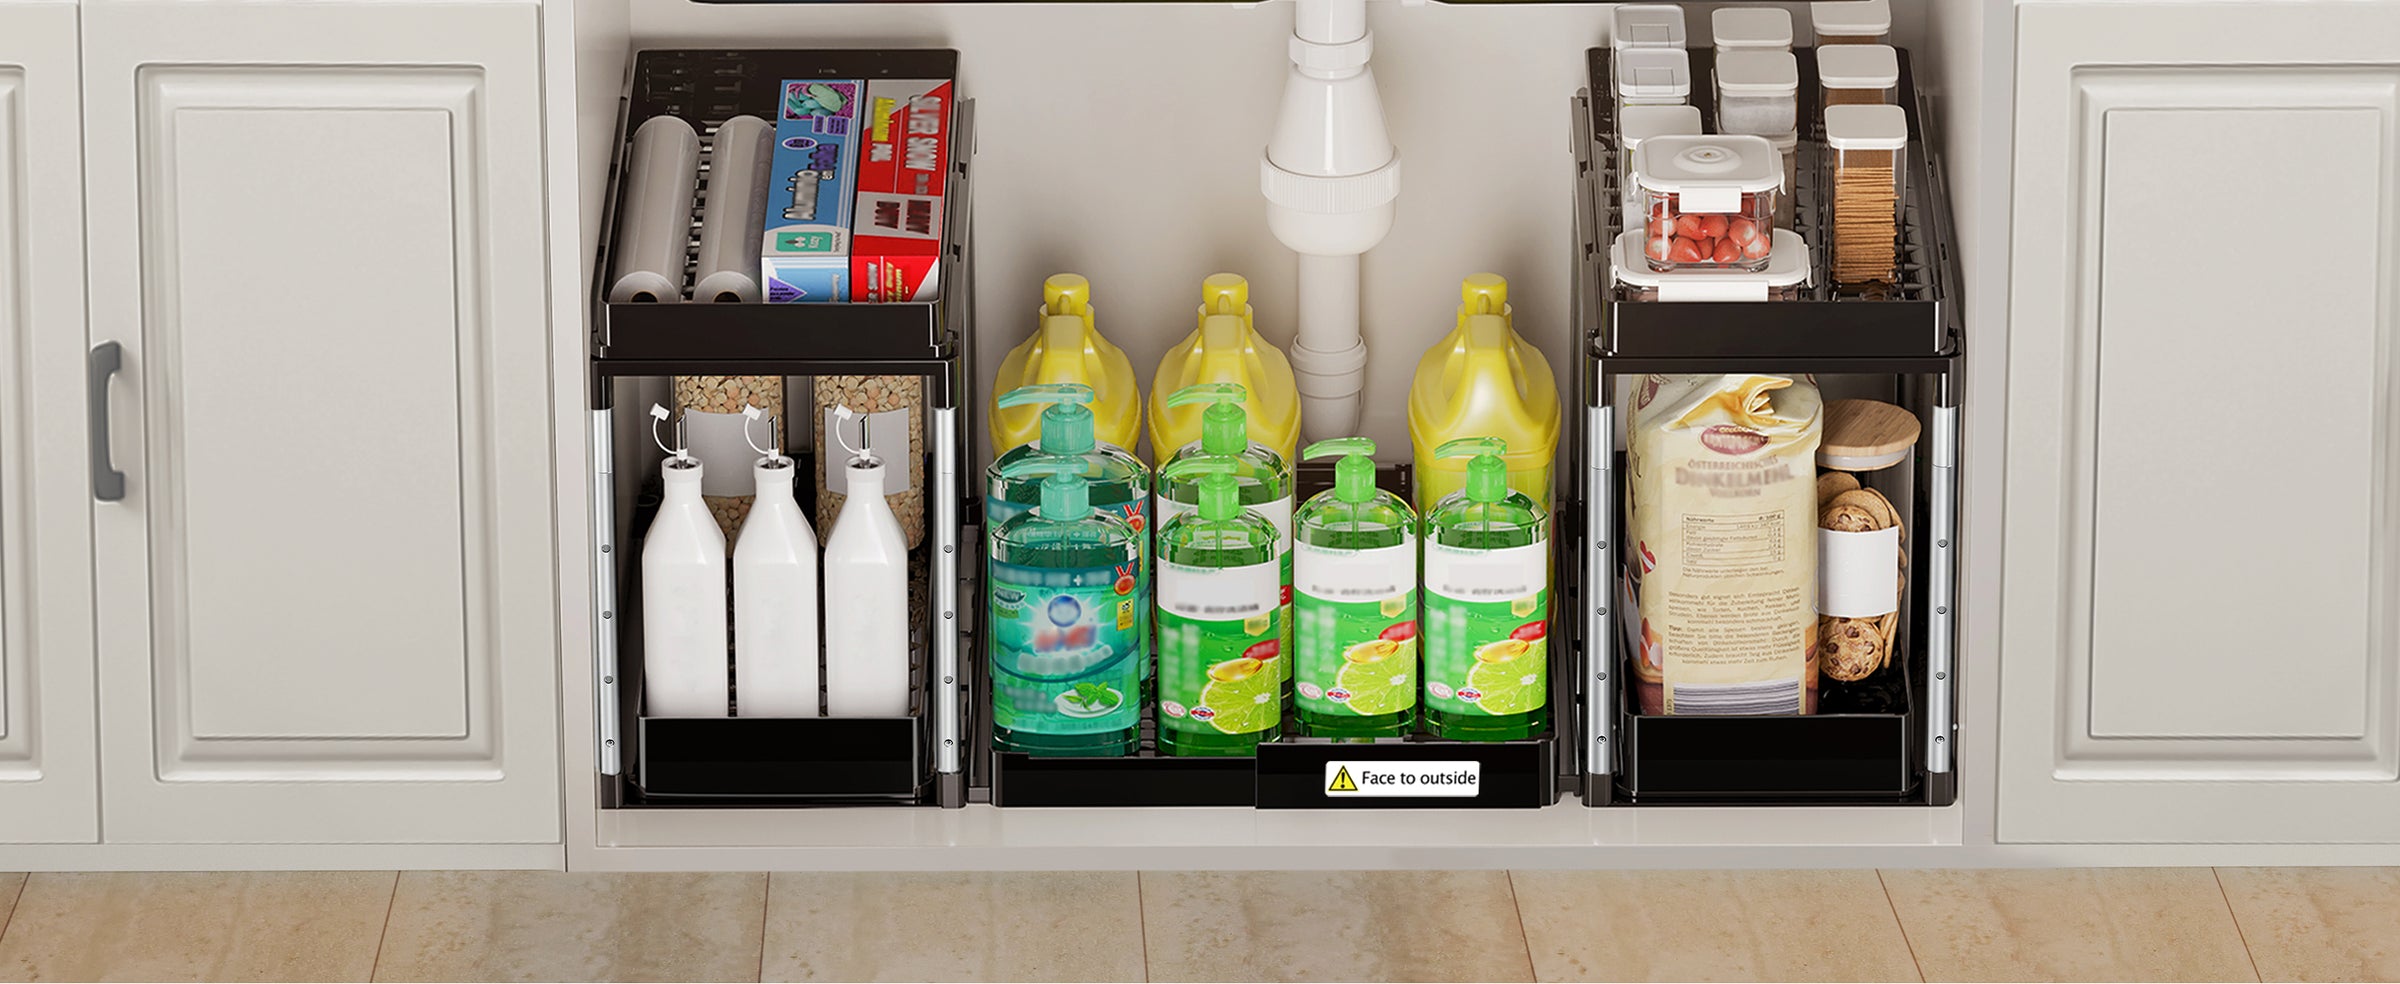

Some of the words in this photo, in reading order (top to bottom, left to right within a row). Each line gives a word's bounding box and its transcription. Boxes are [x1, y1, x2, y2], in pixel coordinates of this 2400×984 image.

[1362, 771, 1396, 785] Face
[1400, 772, 1416, 785] to
[1420, 770, 1476, 785] outside
